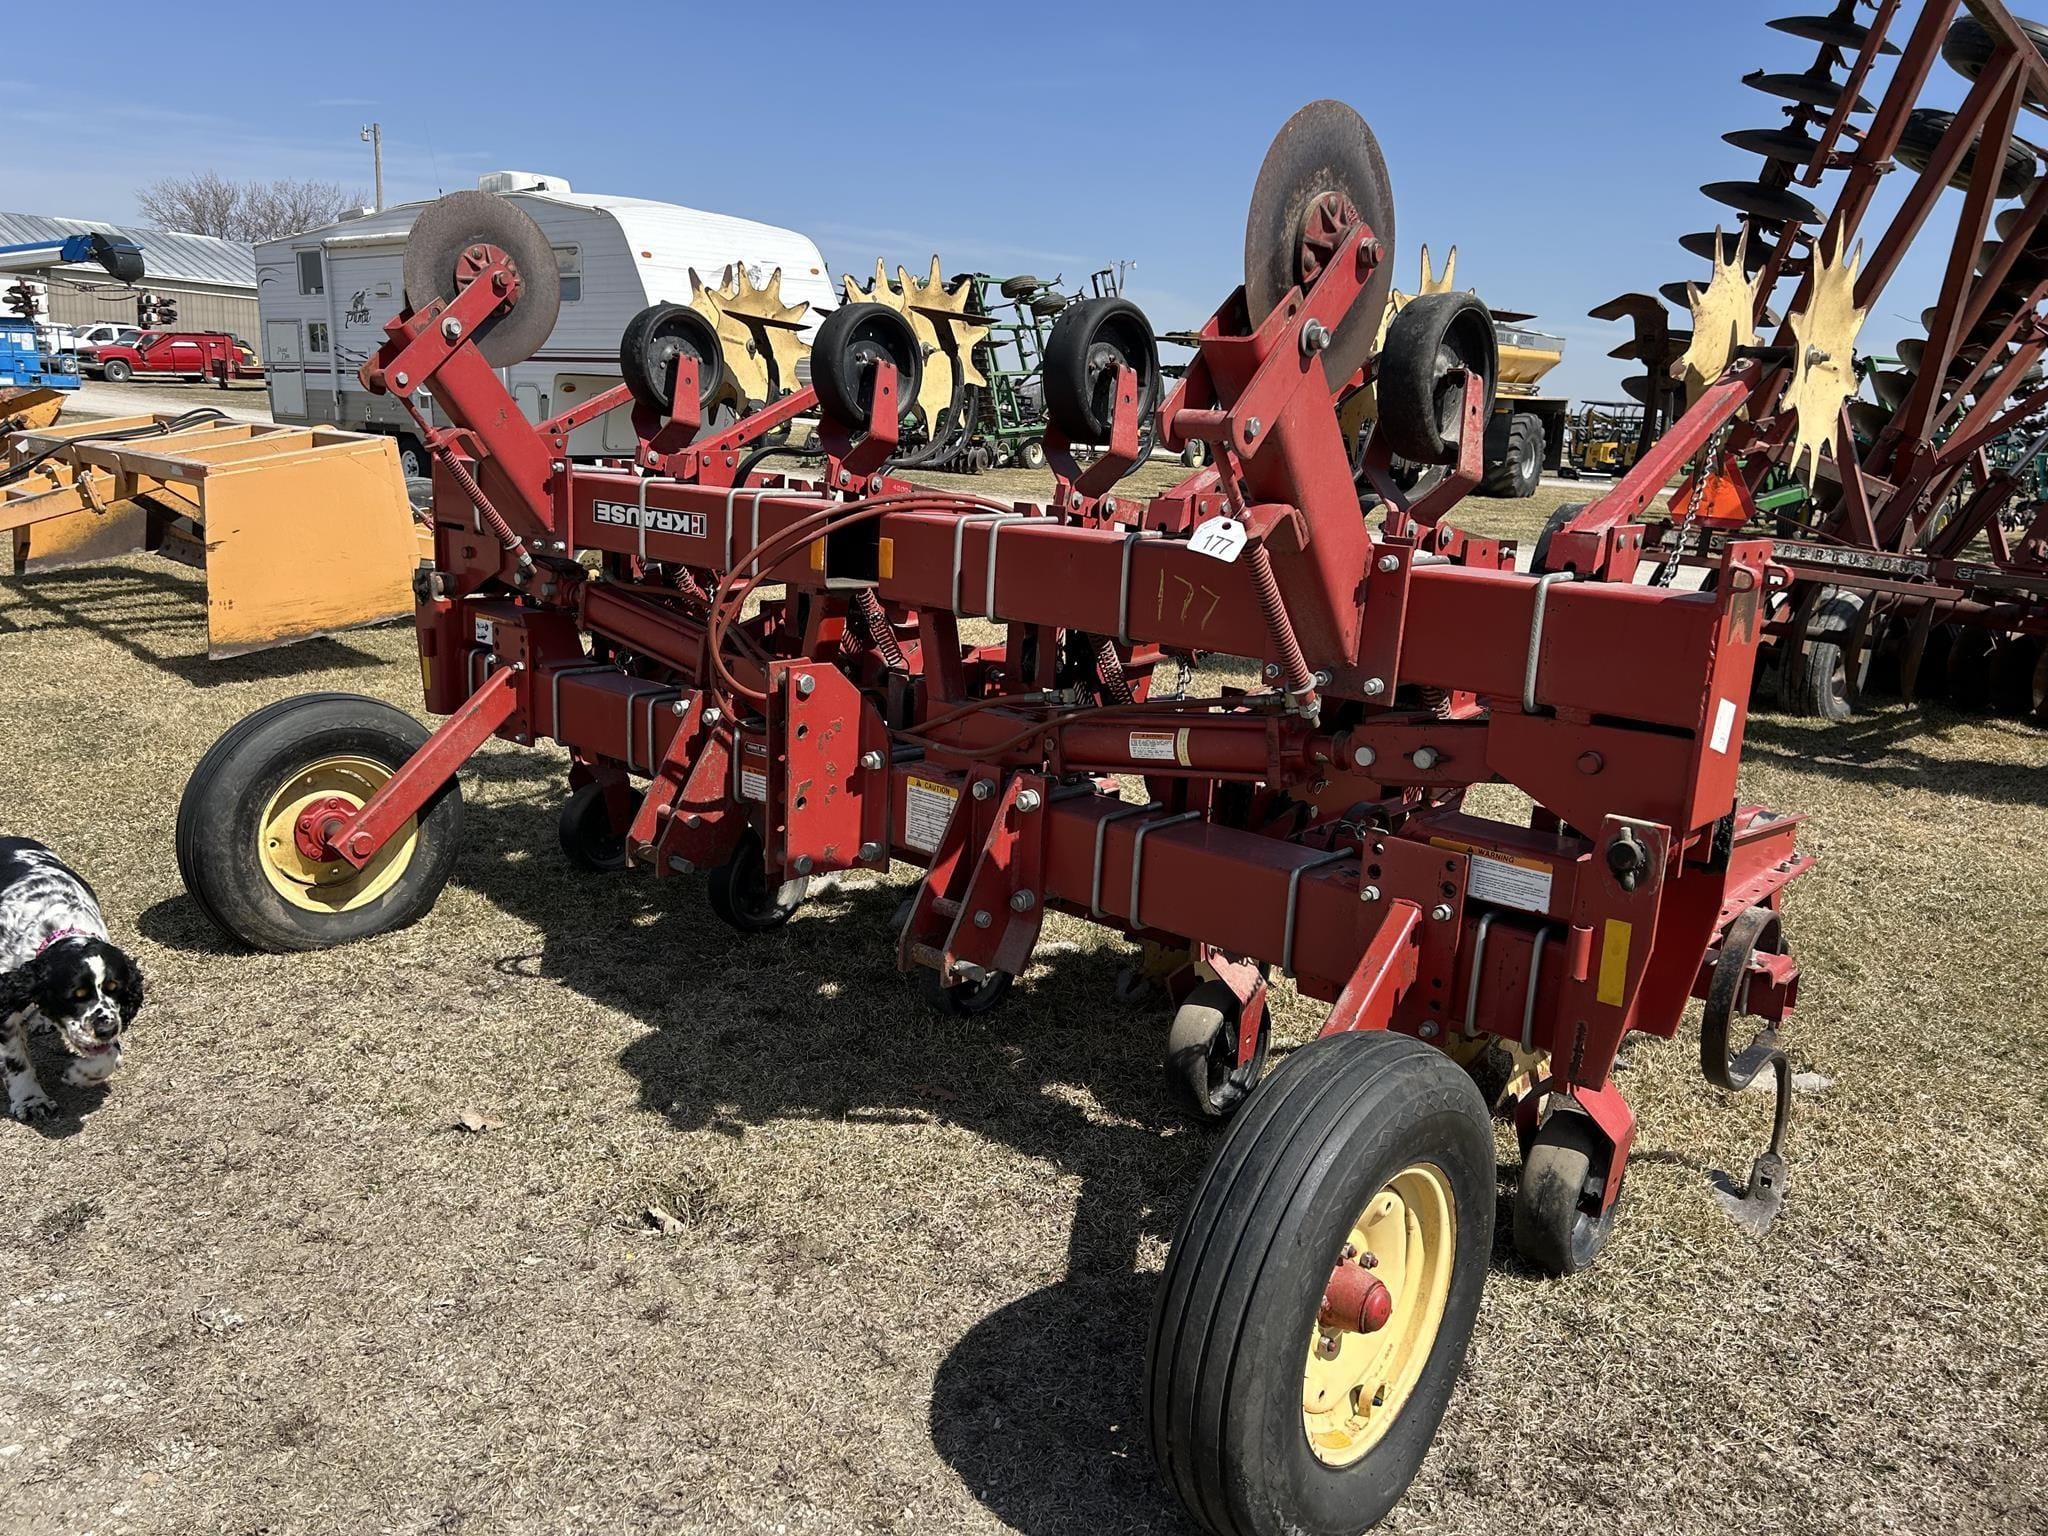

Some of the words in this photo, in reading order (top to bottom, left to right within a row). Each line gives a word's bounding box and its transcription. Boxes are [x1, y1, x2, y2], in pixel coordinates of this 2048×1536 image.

[597, 503, 690, 533] KRAUSE
[1203, 534, 1235, 555] 177
[1157, 568, 1221, 631] 177
[924, 783, 950, 795] CAUTION
[1478, 849, 1514, 864] WARNING
